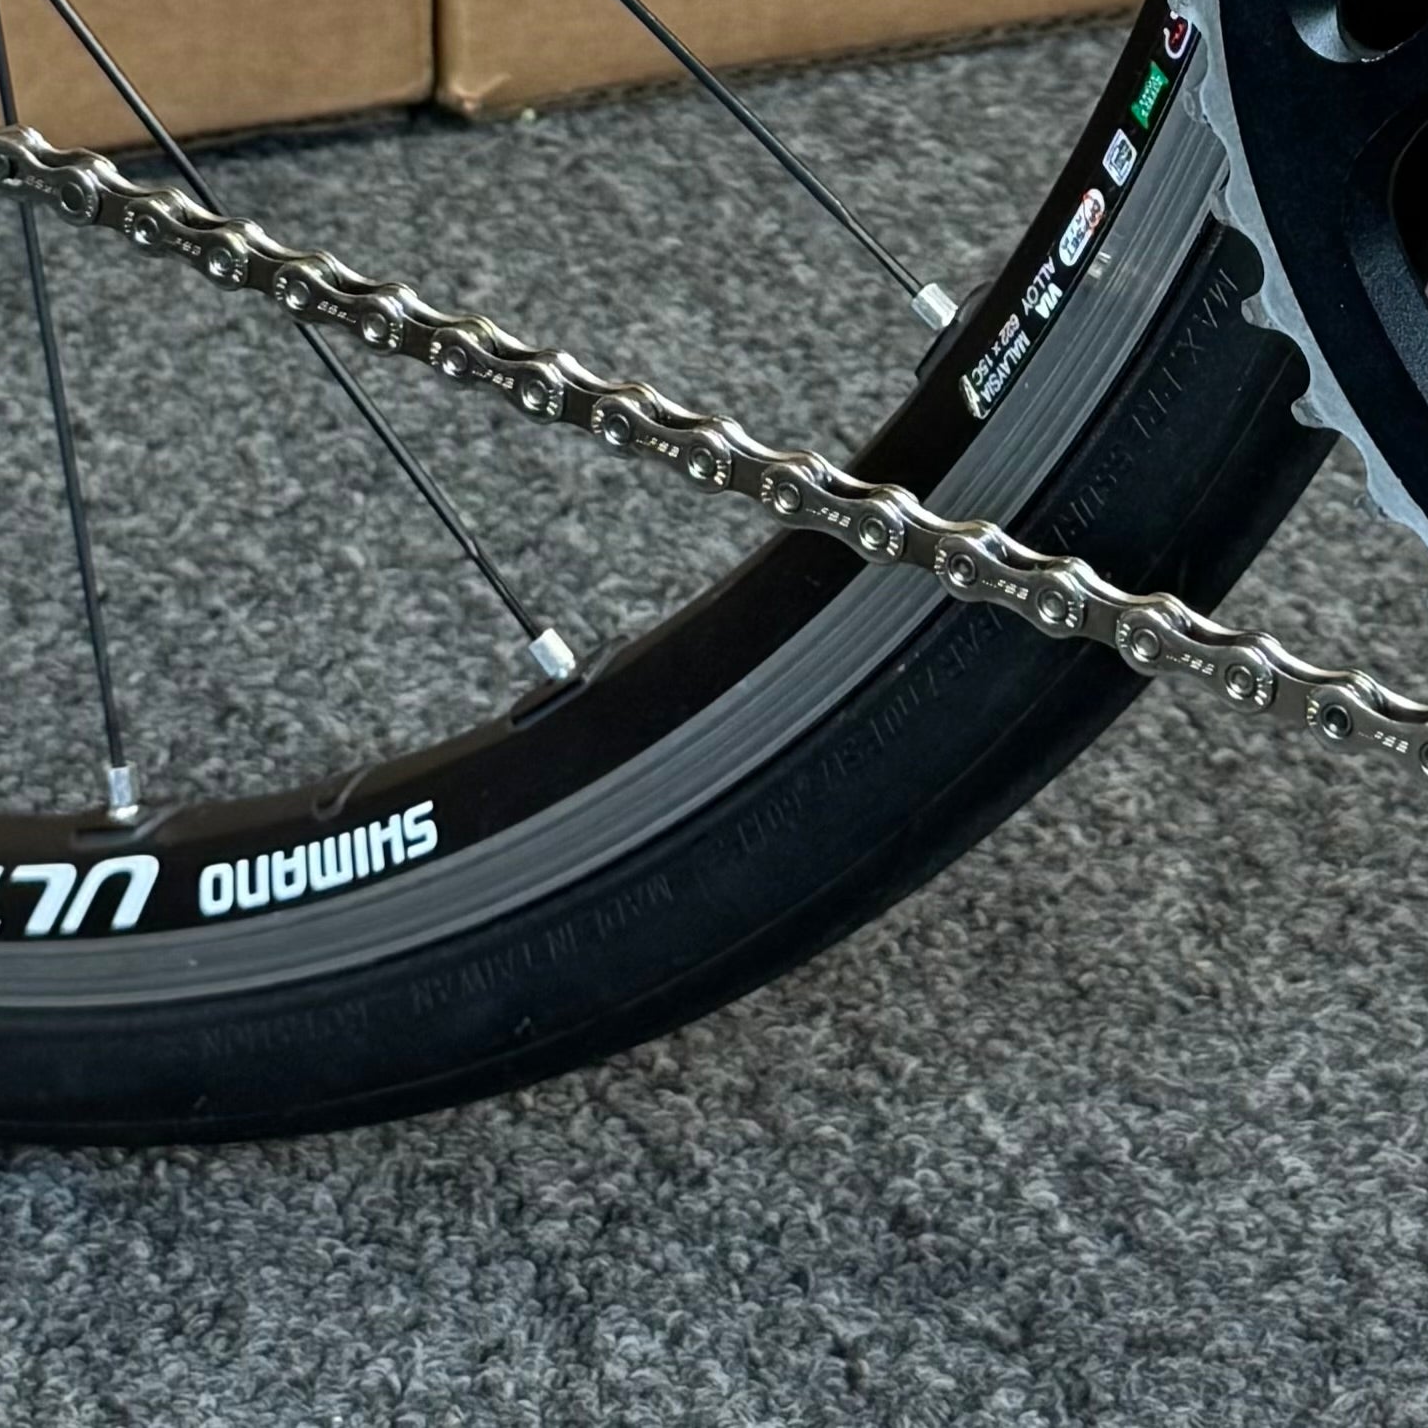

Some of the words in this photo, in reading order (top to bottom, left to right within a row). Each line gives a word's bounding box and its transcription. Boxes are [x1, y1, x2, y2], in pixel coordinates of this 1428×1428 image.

[1022, 255, 1056, 316] ALLOY
[998, 312, 1021, 343] 622
[980, 330, 1031, 404] MALAYSIA
[198, 799, 439, 918] SHIMANO
